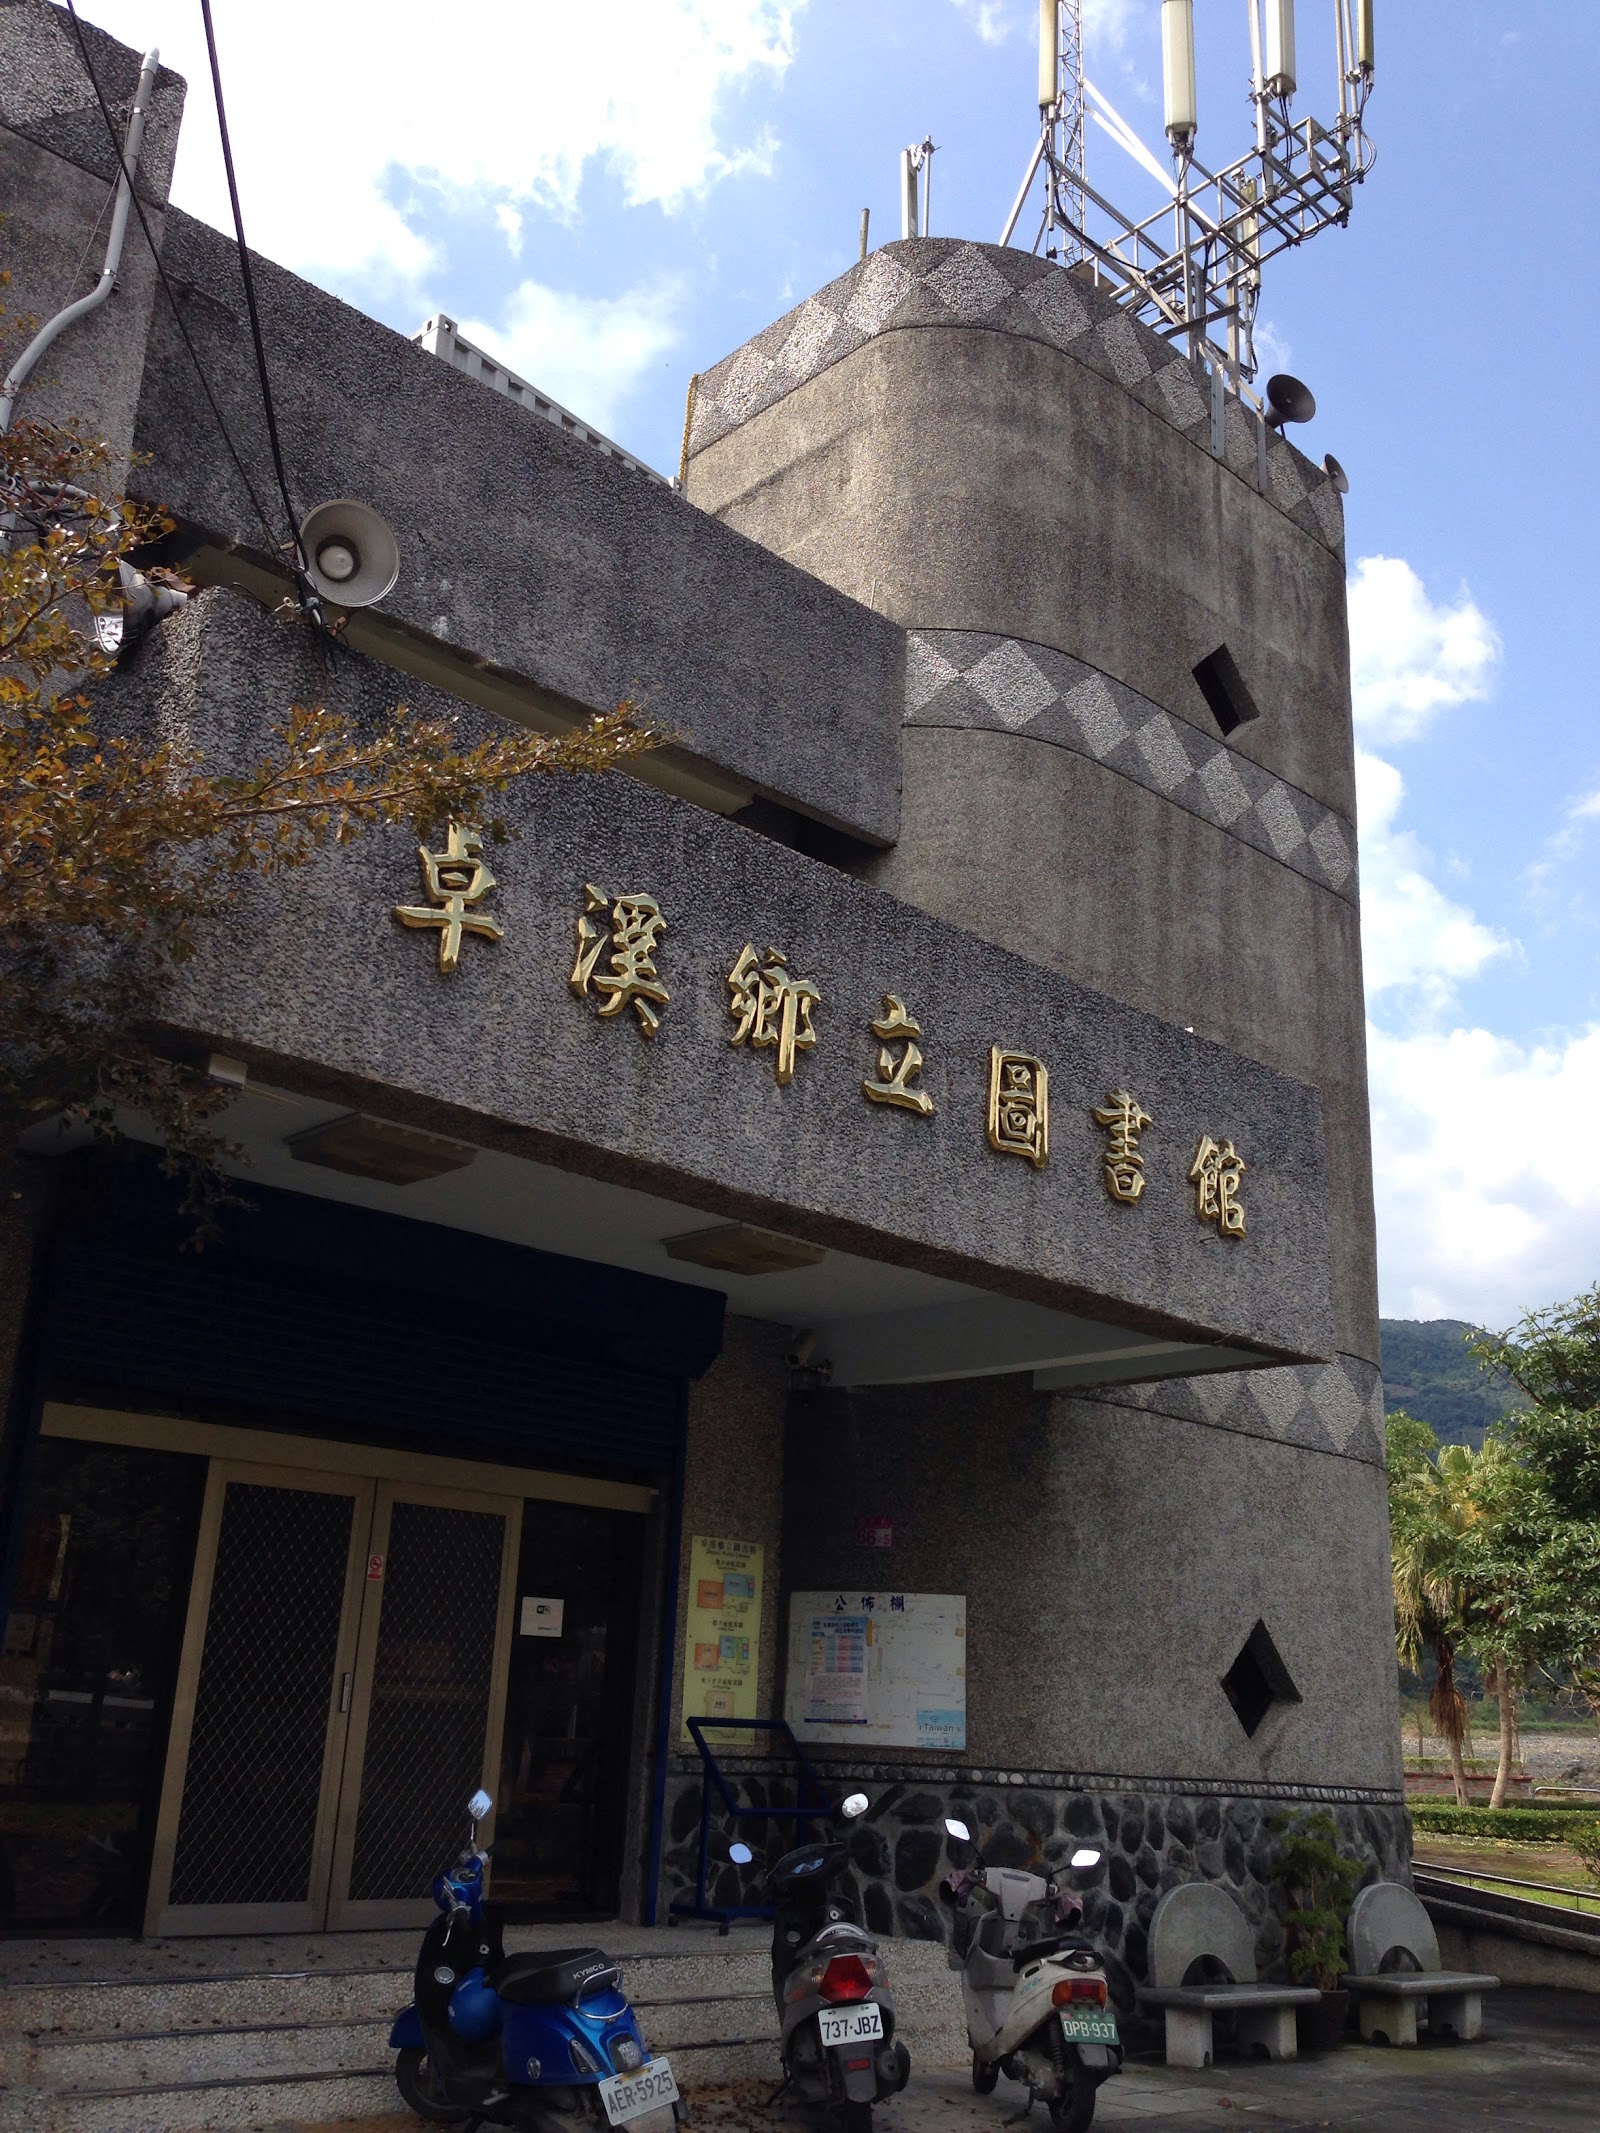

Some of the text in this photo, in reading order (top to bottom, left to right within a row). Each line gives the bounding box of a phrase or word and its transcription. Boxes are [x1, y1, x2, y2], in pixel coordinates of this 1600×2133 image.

[394, 818, 1247, 1238] 卓溪鄉立圖書館
[572, 1962, 605, 1981] KYMCO
